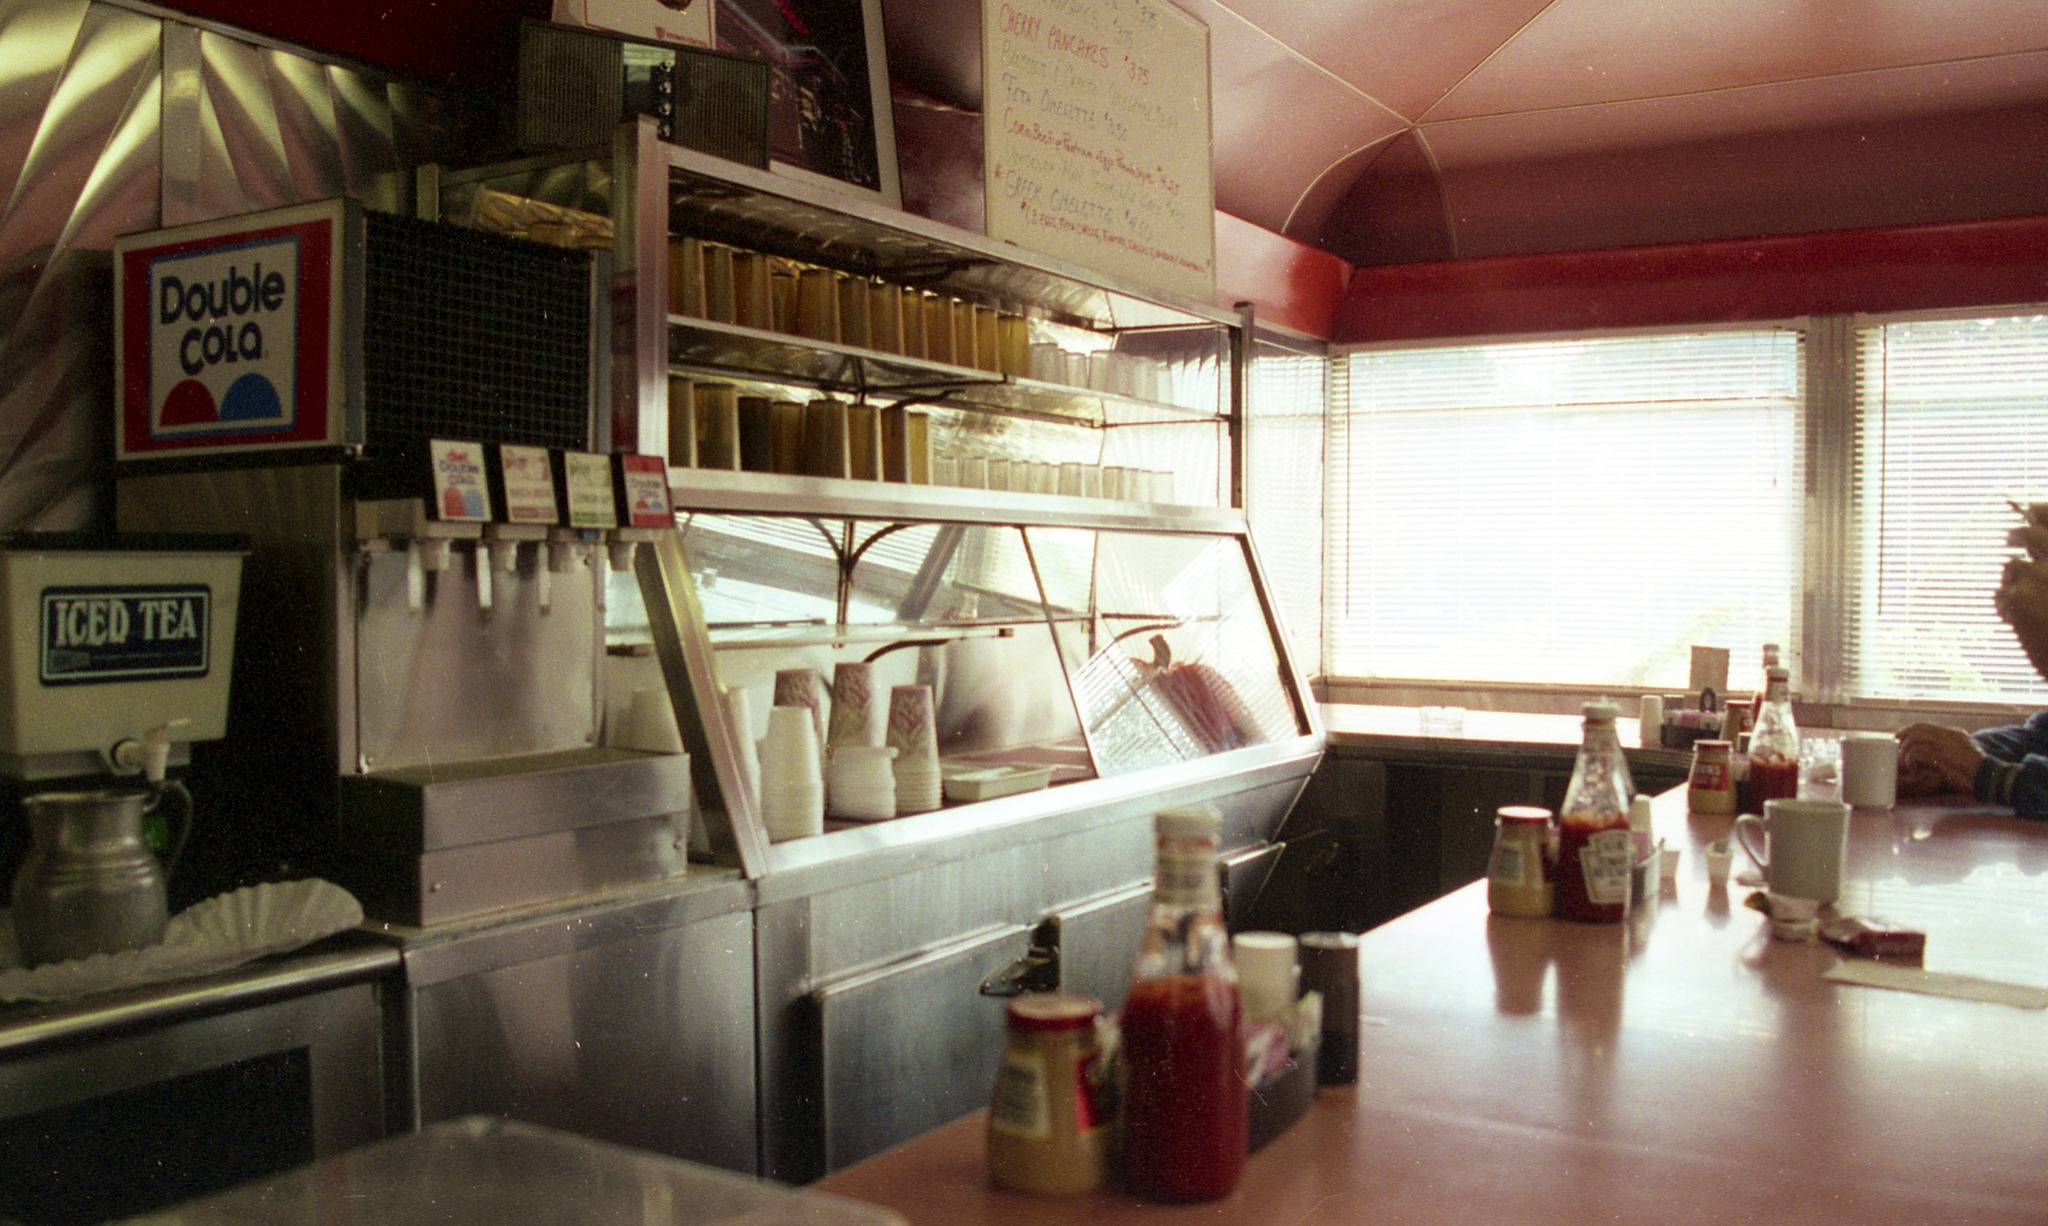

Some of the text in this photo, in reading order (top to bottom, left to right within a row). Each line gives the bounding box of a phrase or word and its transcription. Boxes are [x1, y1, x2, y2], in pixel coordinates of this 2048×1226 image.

[999, 2, 1042, 42] CHERRY
[1047, 25, 1109, 68] PANCAKES
[1040, 88, 1096, 129] OMELETTE
[1005, 169, 1043, 203] GREEK
[1050, 187, 1114, 225] OMELETTE
[159, 262, 286, 326] Double
[54, 599, 198, 648] ICED TEA
